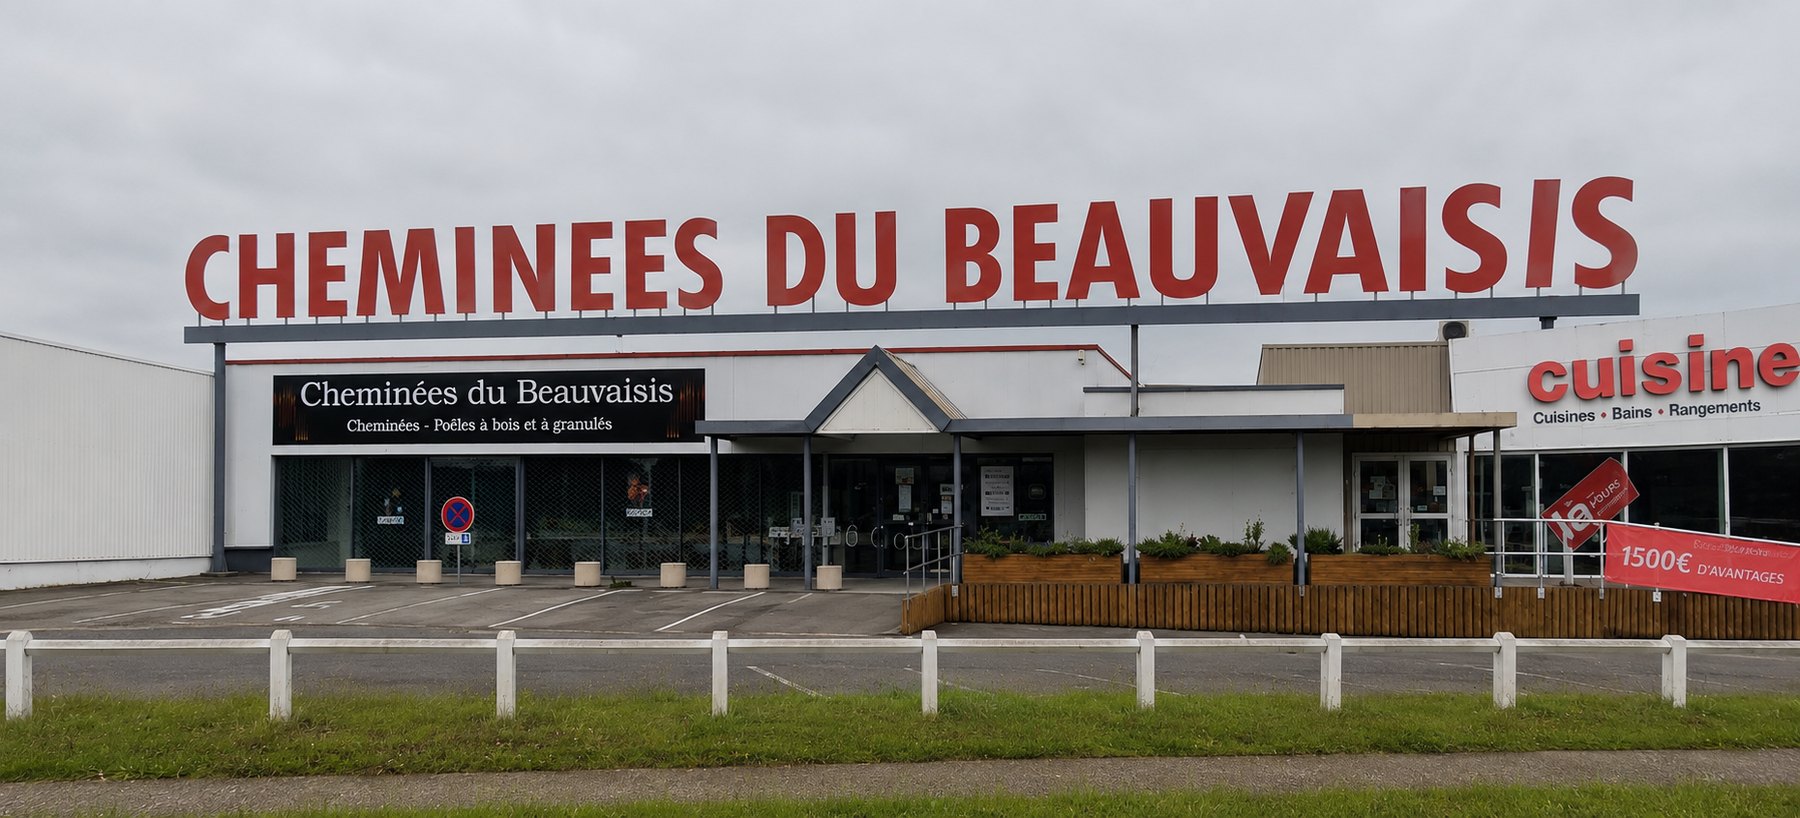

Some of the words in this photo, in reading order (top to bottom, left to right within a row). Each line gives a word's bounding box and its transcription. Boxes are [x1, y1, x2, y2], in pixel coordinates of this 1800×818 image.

[184, 217, 724, 321] CHEMINEES
[766, 210, 897, 307] DU
[944, 176, 1639, 304] BEAUVAISIS
[1527, 333, 1800, 402] cuisine
[300, 380, 458, 407] Cheminées
[467, 379, 507, 404] du
[516, 377, 674, 404] Beauvaisis
[346, 418, 420, 433] Cheminées
[433, 417, 476, 432] Poêles
[479, 418, 489, 431] à
[492, 417, 520, 431] bois
[523, 419, 537, 431] et
[540, 417, 550, 431] à
[552, 416, 613, 434] granulés
[1533, 409, 1596, 425] Cuisines
[1612, 406, 1653, 421] Bains
[1669, 399, 1761, 418] Rangements
[1622, 545, 1693, 574] 1500€
[1697, 563, 1785, 585] D'AVANTAGES
